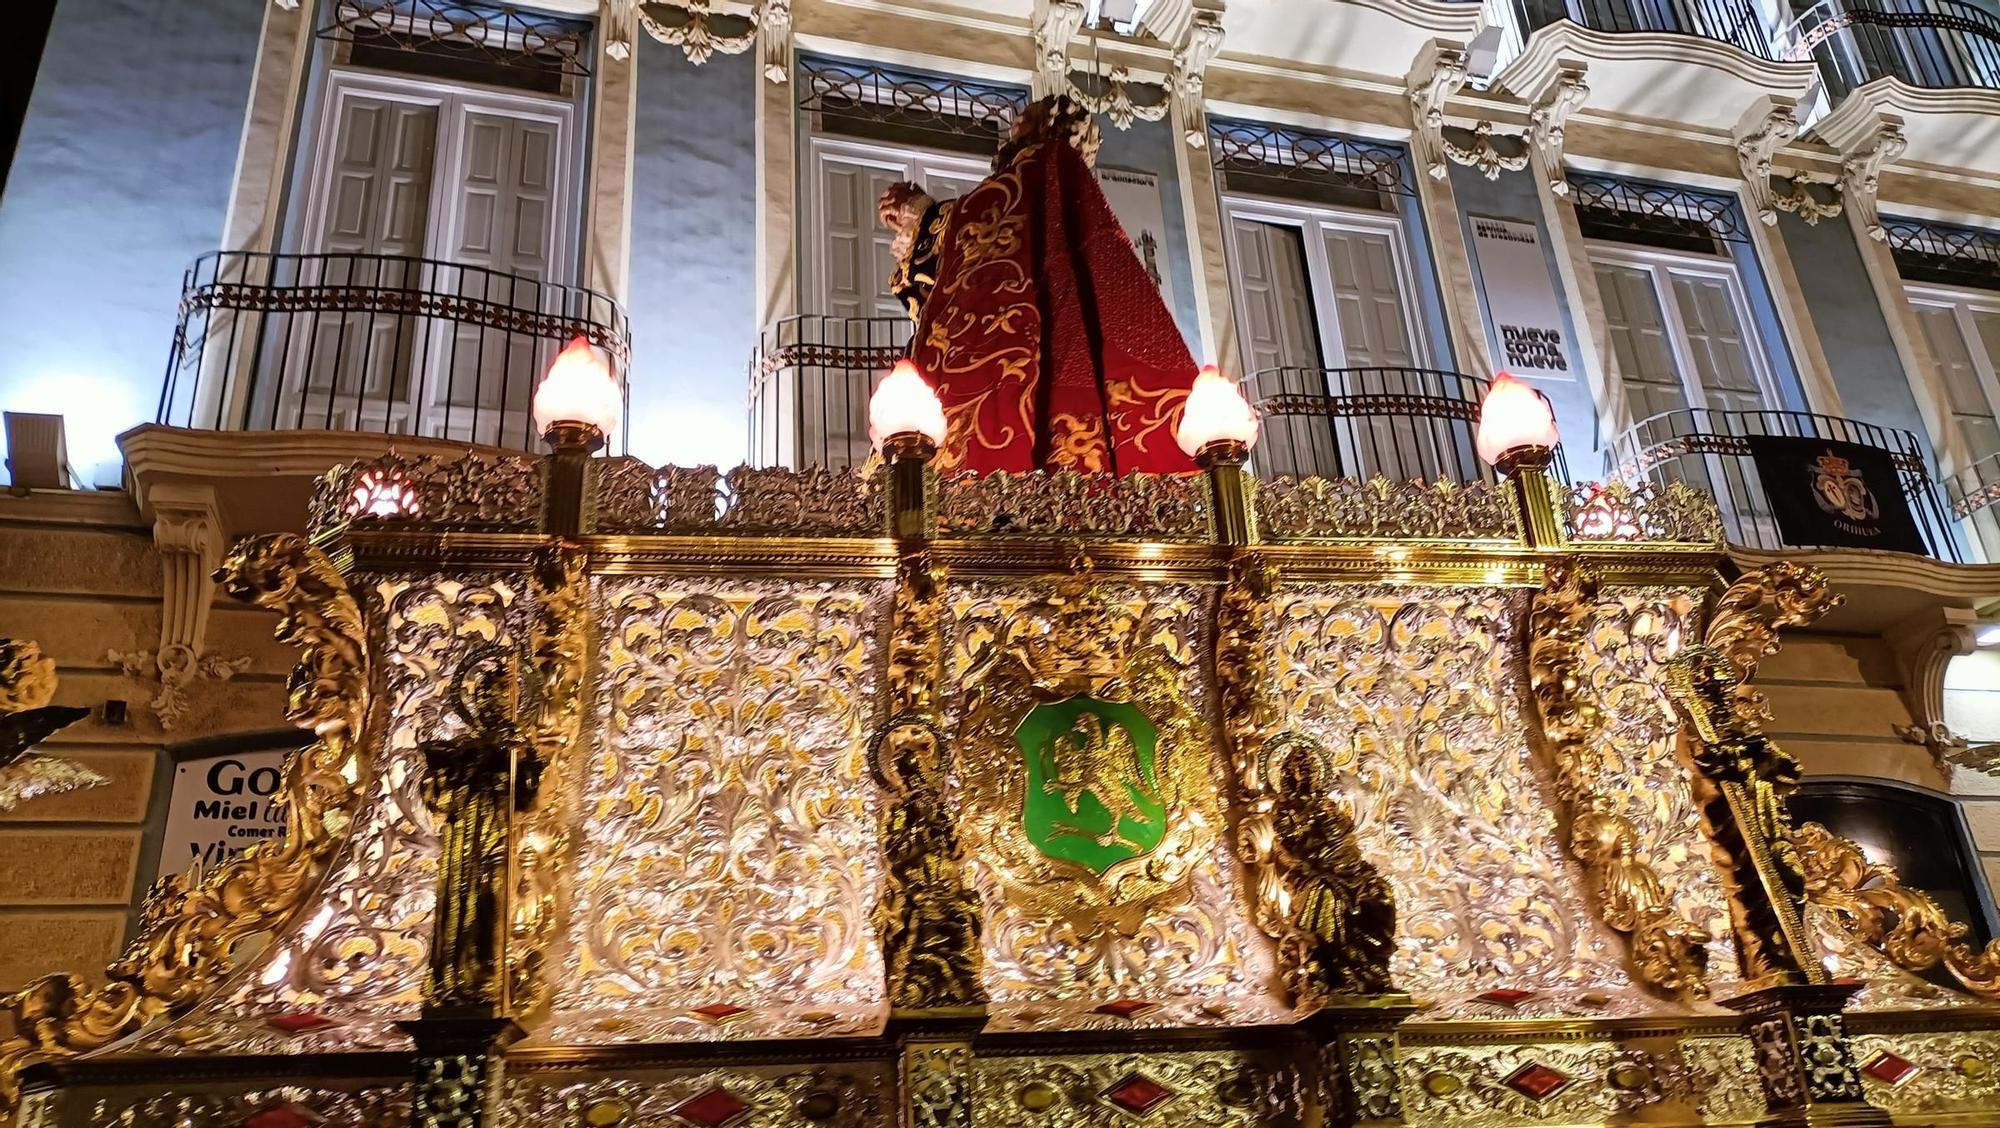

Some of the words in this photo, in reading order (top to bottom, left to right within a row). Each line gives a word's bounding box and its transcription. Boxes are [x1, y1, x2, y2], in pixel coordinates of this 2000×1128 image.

[1500, 325, 1561, 344] nueve
[1504, 340, 1559, 357] coma
[1506, 352, 1567, 371] nueve
[193, 800, 258, 820] Miel
[228, 825, 275, 837] Comer
